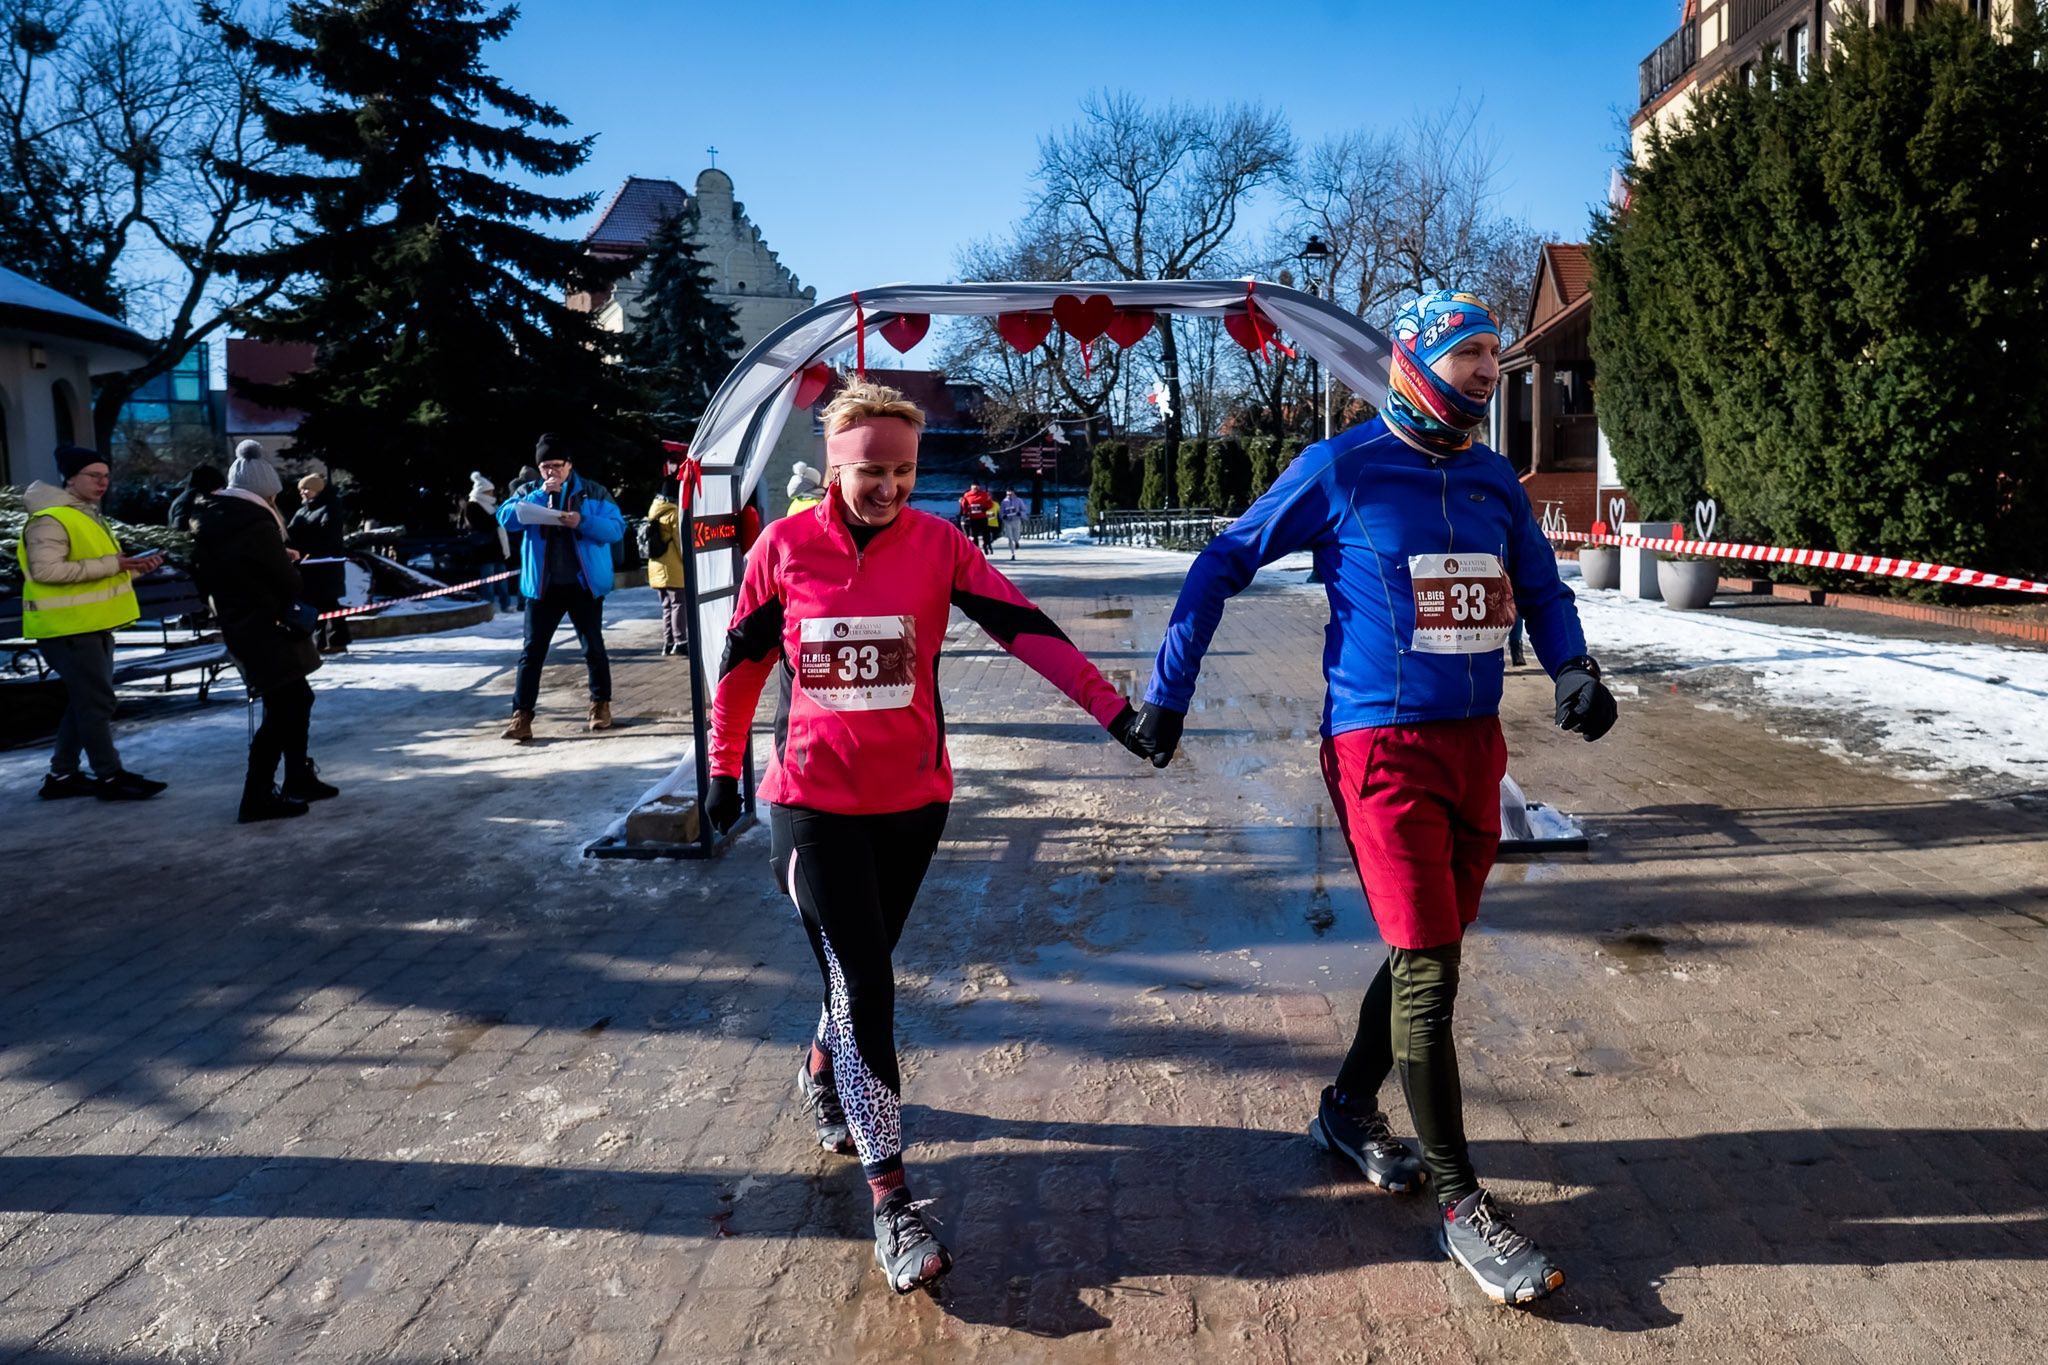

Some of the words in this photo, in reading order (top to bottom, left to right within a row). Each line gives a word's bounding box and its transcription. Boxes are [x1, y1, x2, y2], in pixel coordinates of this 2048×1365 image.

[1423, 311, 1452, 348] 33
[1450, 583, 1486, 621] 33
[837, 645, 880, 681] 33
